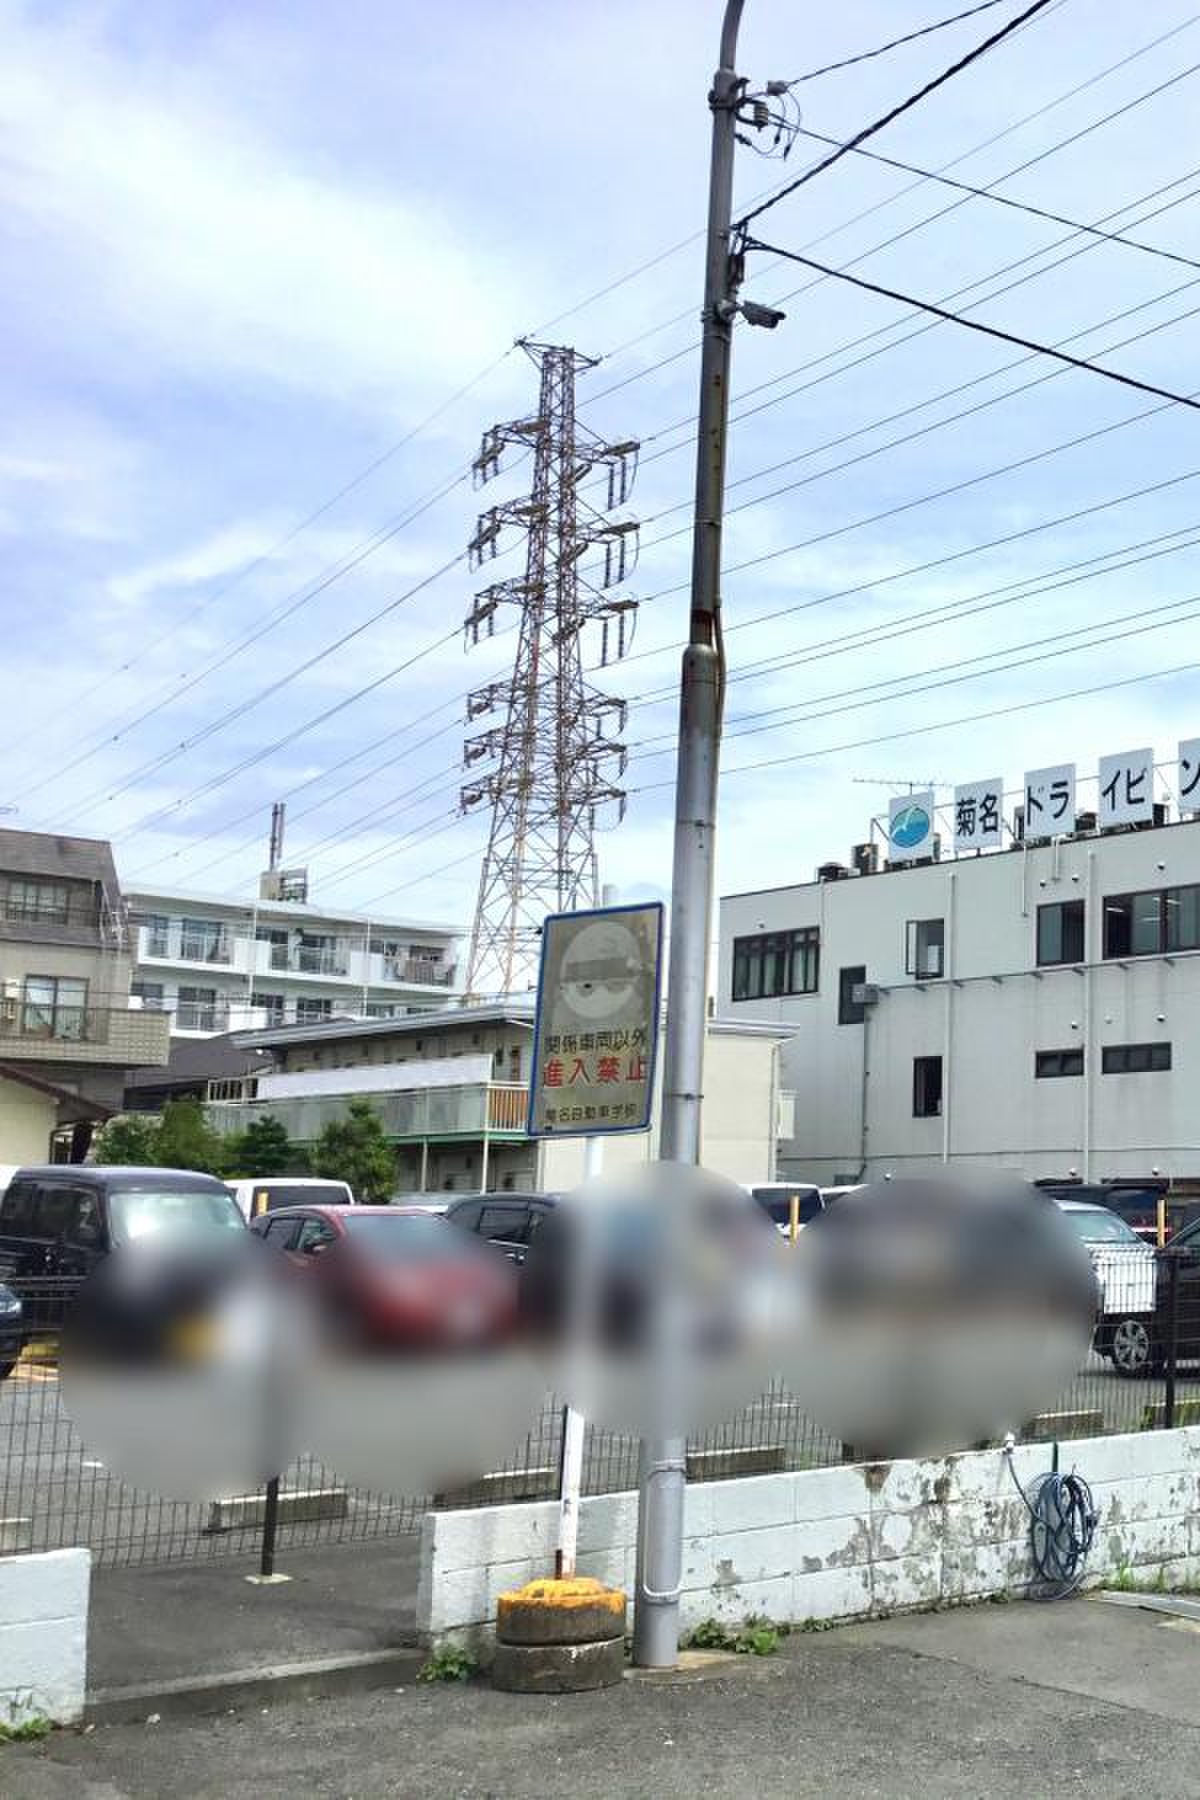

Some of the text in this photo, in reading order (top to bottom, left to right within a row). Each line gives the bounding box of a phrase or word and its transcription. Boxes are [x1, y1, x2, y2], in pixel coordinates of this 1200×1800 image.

[544, 1028, 646, 1054] 関係車両以外
[543, 1056, 647, 1087] 進入禁止
